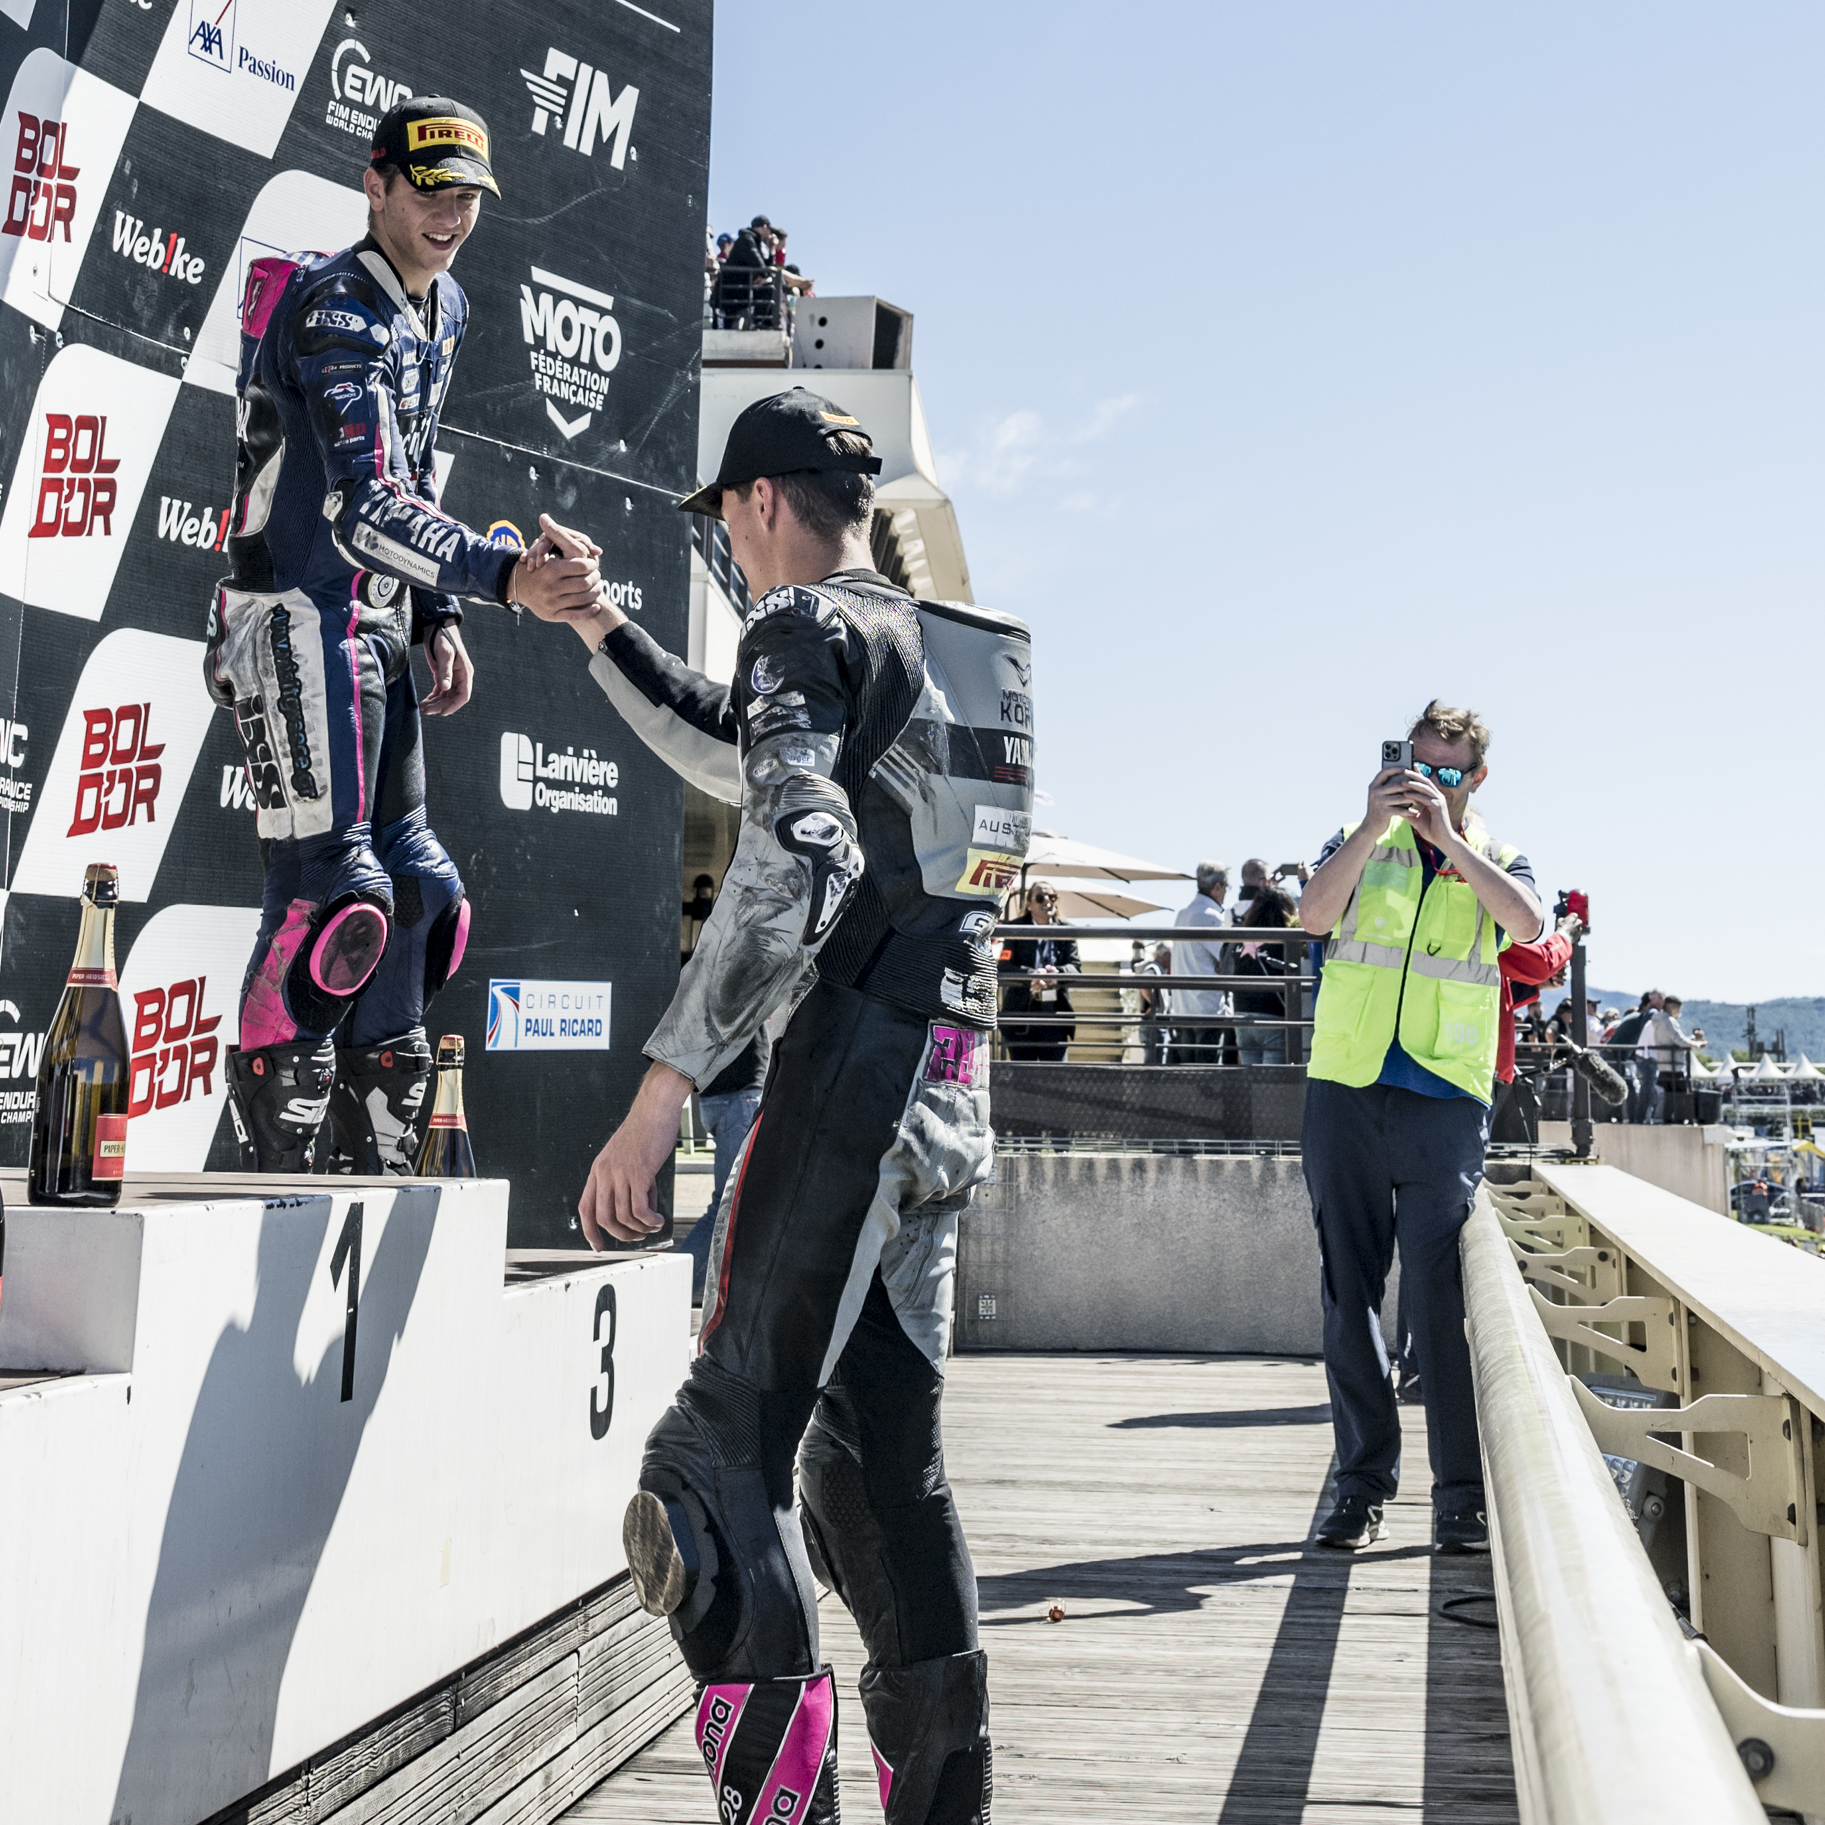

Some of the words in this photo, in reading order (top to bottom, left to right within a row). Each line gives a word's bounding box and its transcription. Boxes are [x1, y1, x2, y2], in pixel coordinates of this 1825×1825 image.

[189, 20, 224, 61] AXA
[238, 46, 296, 92] Passion
[325, 113, 355, 137] WORLD
[327, 100, 351, 121] FIM
[519, 46, 640, 170] FIM
[14, 110, 82, 182] BOL
[417, 122, 485, 151] PIRELLI
[1, 178, 78, 243] D'OR
[520, 282, 622, 373] MOTO
[530, 348, 610, 394] FÉDÉRATION
[534, 371, 605, 413] FRANÇAISE
[42, 413, 121, 474] BOL
[27, 477, 118, 539] D'OR
[378, 544, 436, 580] MOTODYNAMICS
[601, 579, 643, 610] ports
[81, 702, 167, 771] BOL
[534, 742, 620, 789] Larivière
[66, 762, 163, 839] D'OR
[534, 781, 618, 816] Organisation
[131, 975, 223, 1055] BOL
[525, 992, 605, 1010] CIRCUIT
[524, 1017, 557, 1038] PAUL
[559, 1017, 603, 1038] RICARD
[1446, 1021, 1478, 1046] 100
[330, 1201, 364, 1403] 1
[589, 1283, 615, 1441] 3
